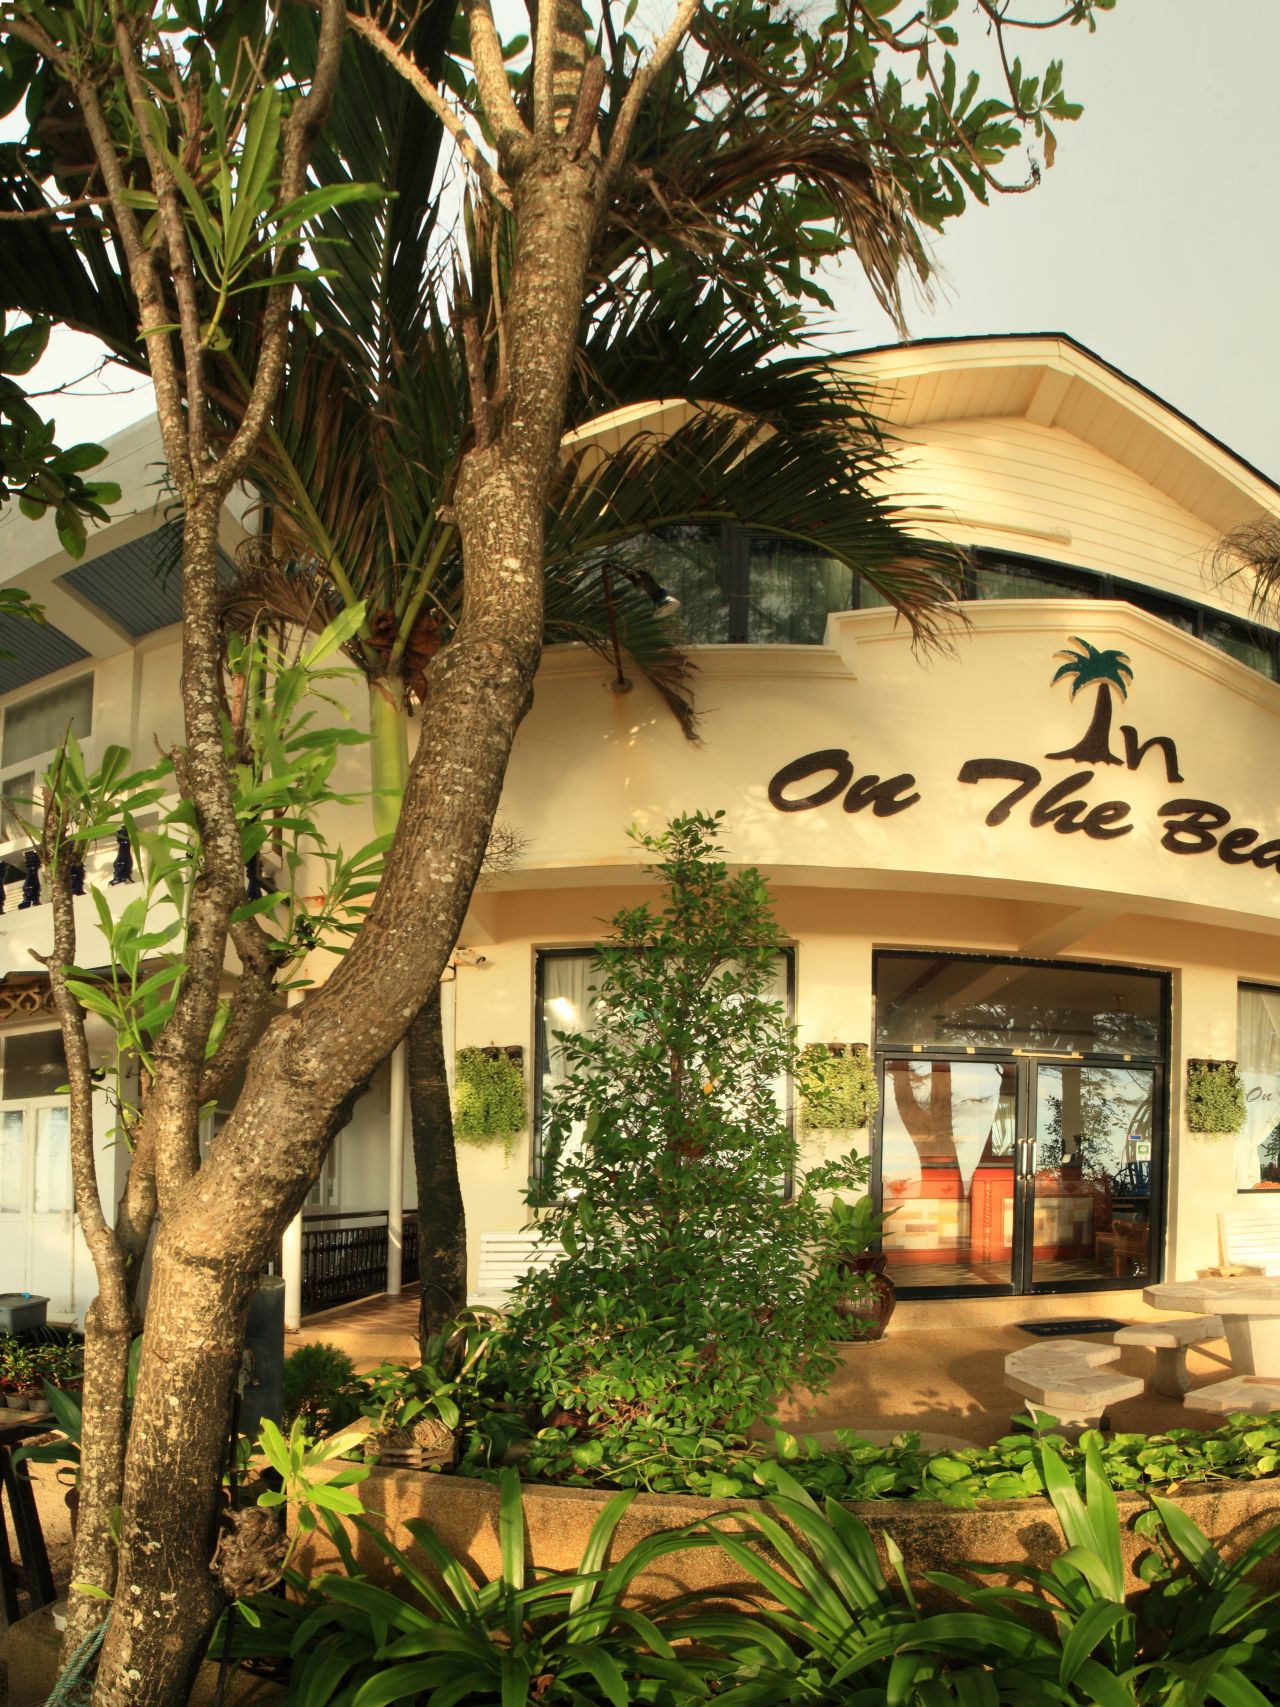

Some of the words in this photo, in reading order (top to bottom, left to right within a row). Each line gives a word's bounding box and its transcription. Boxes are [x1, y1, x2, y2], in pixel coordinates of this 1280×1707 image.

[768, 749, 921, 817] On
[957, 758, 1134, 840] The
[1246, 1086, 1272, 1102] On
